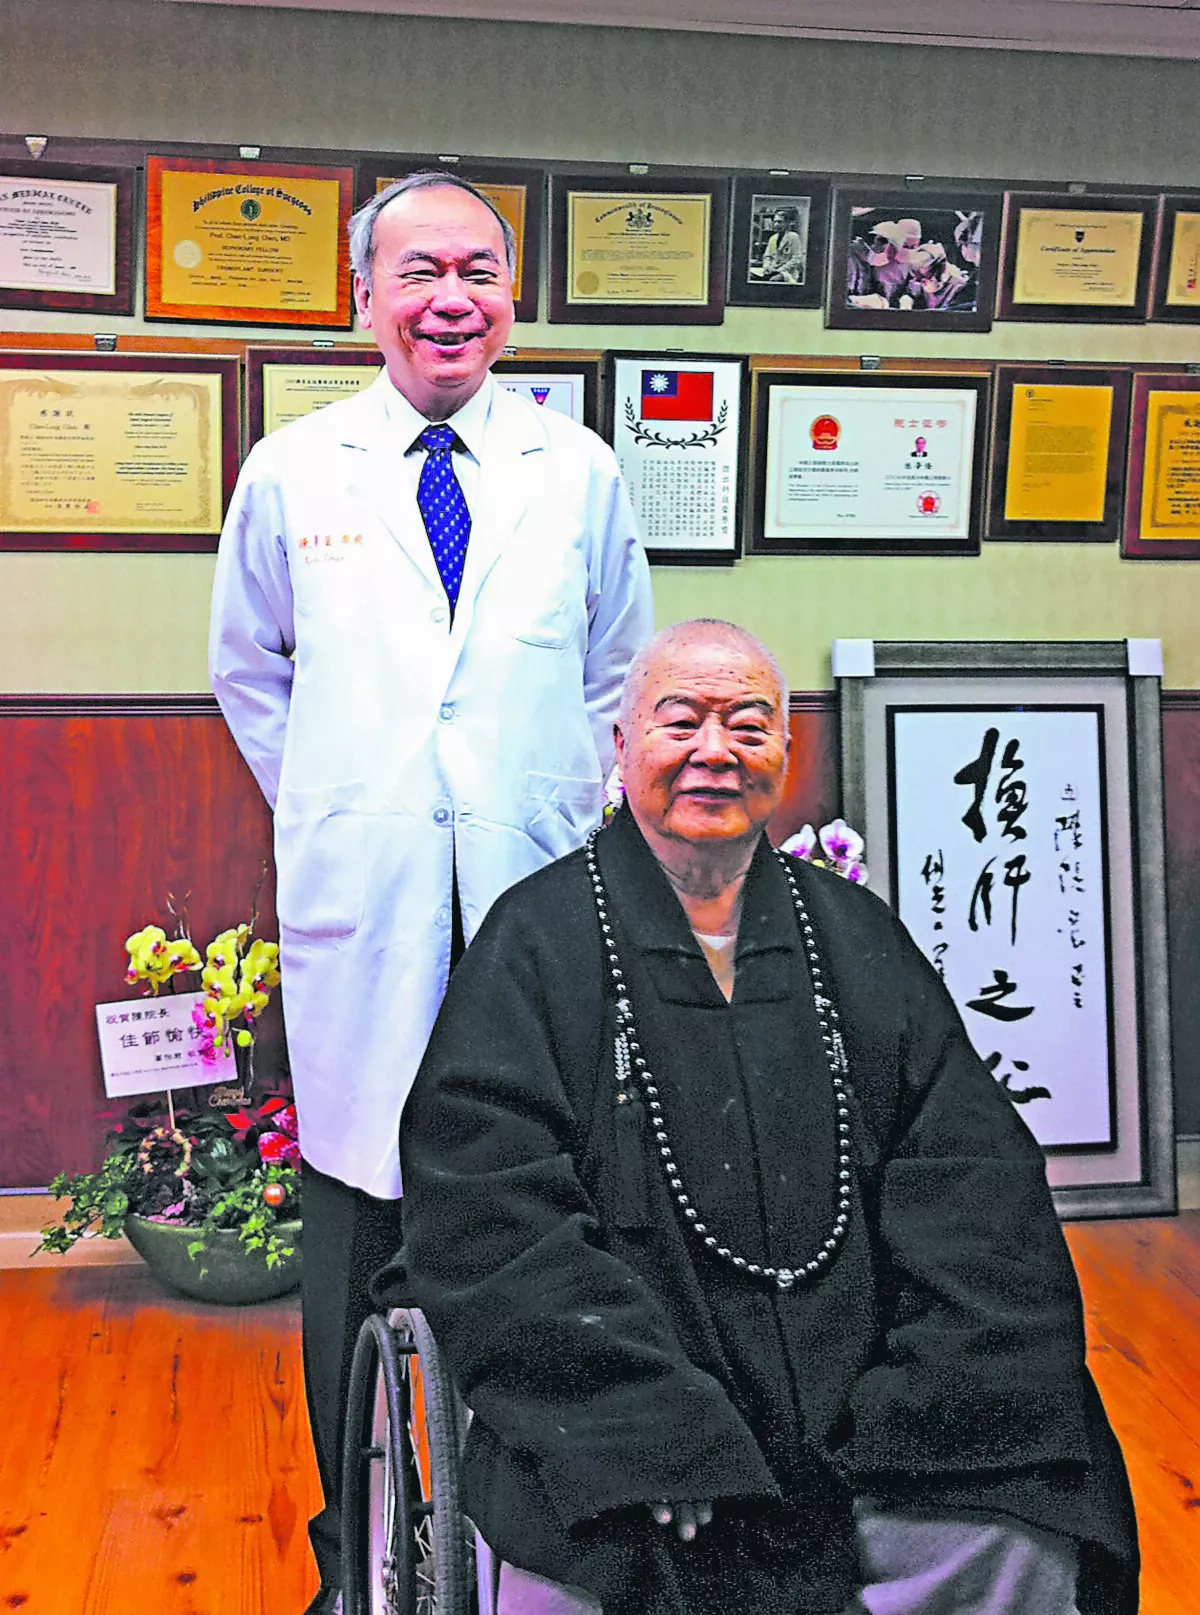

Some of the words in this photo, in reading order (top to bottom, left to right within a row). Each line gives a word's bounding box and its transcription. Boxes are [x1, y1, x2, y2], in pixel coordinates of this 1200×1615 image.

[192, 186, 234, 212] Philippine
[235, 184, 265, 196] College
[266, 187, 275, 197] of
[276, 187, 312, 216] Surgeons
